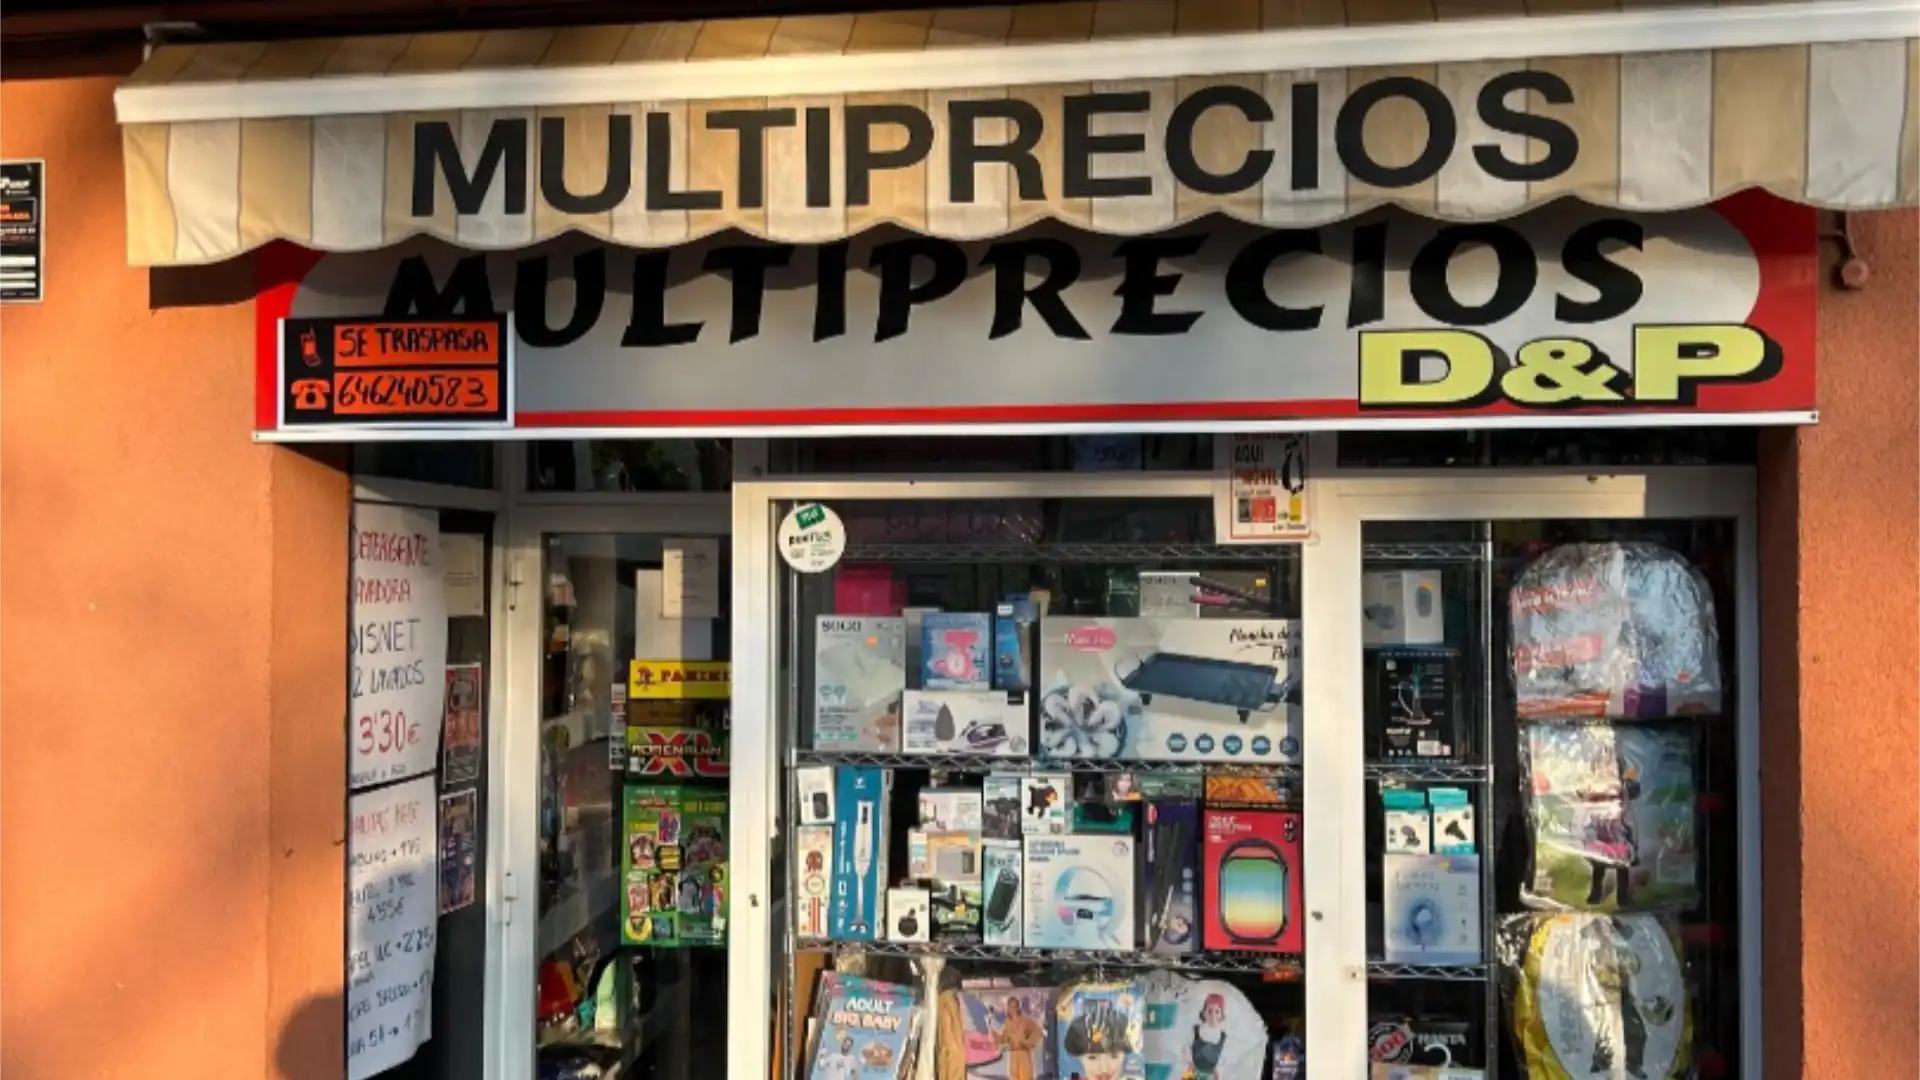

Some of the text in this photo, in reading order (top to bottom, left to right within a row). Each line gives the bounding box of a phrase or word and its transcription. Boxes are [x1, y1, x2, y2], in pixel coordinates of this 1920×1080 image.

[411, 69, 1580, 218] MULTIPRECIOS
[382, 219, 1644, 348] MULTIPRECIOS
[338, 327, 489, 358] SE TRASPASA
[1358, 323, 1784, 411] D&P
[337, 374, 489, 408] 646240583
